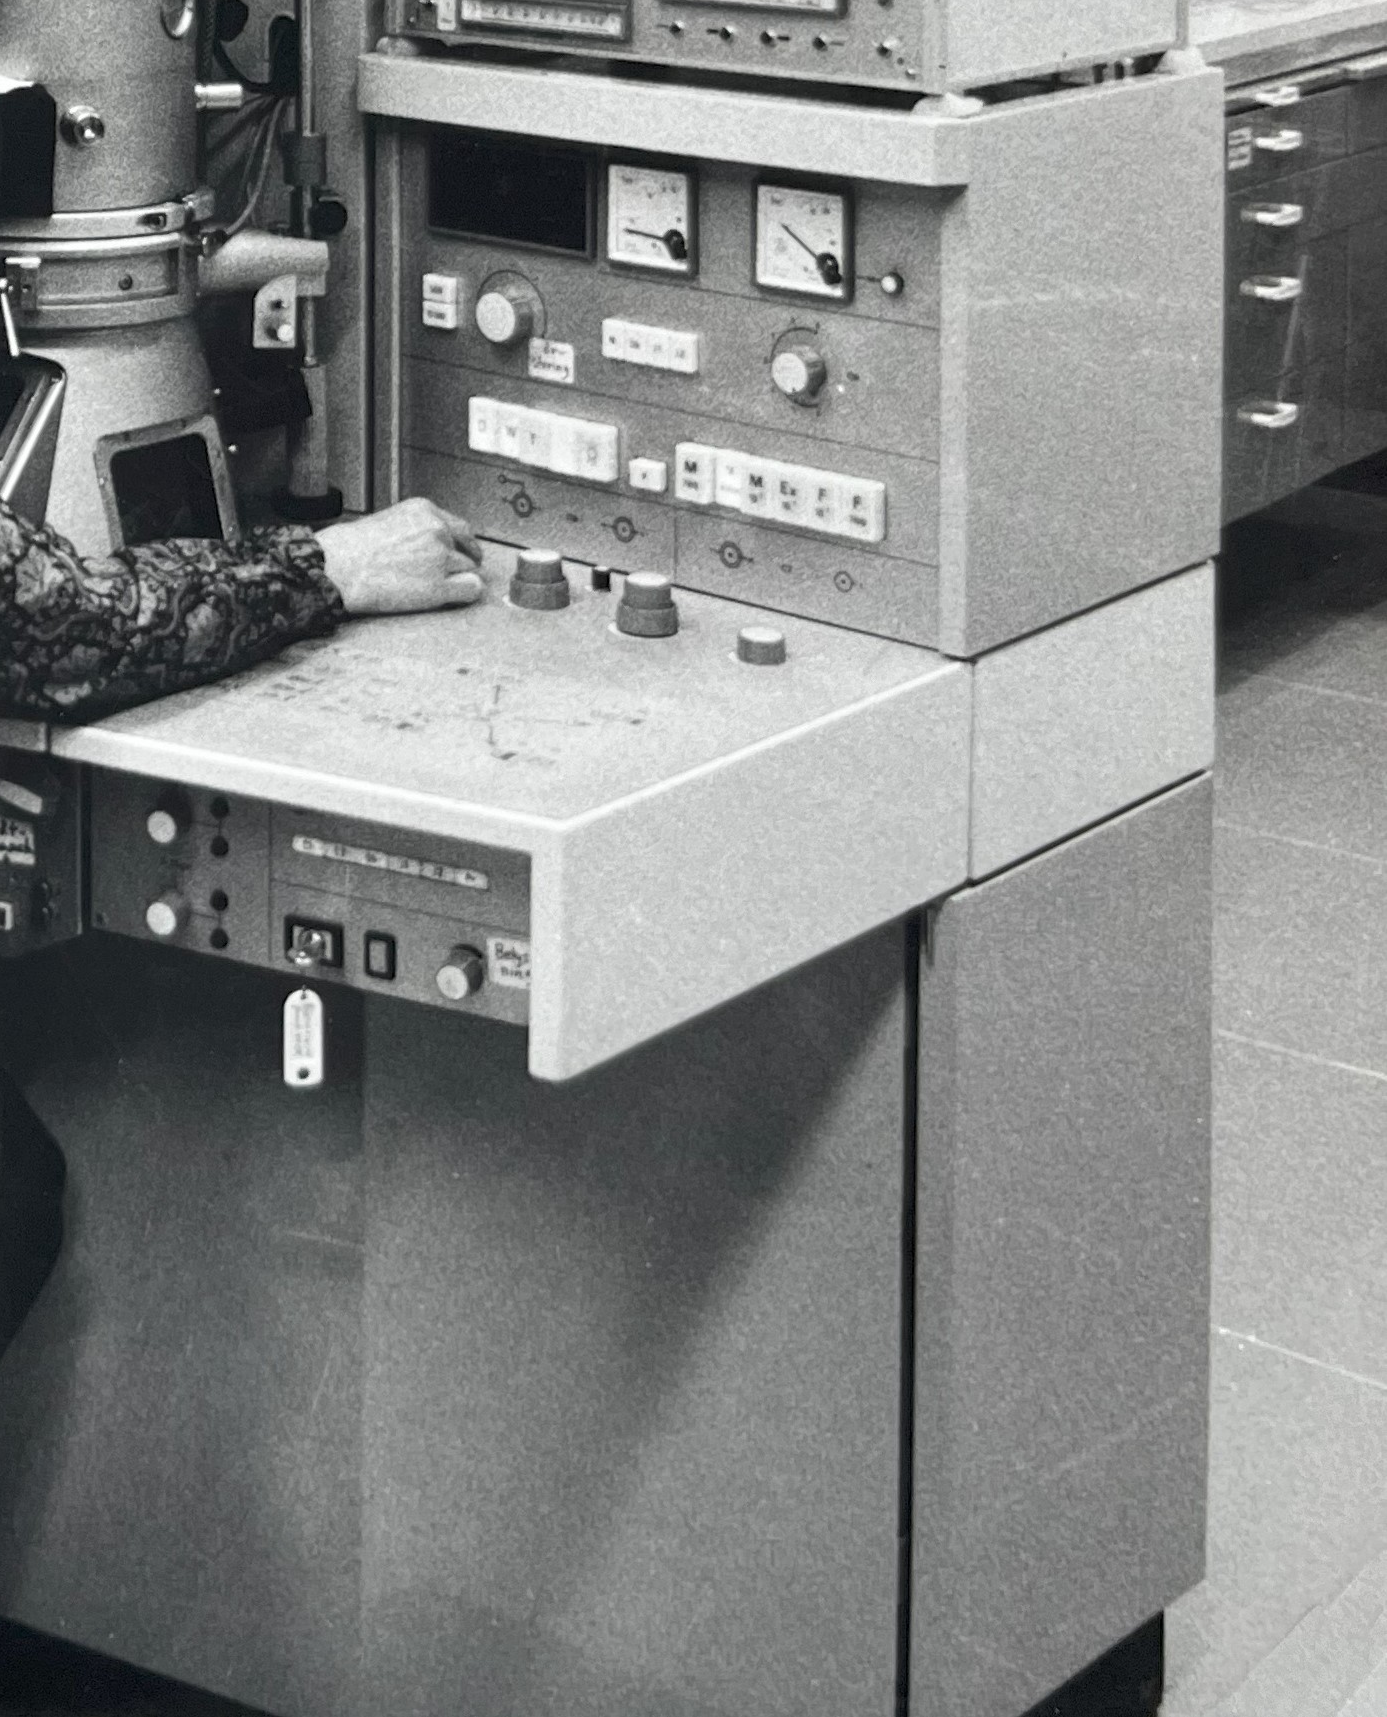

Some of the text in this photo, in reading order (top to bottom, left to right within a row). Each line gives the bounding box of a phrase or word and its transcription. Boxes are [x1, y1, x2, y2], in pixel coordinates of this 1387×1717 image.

[684, 460, 698, 474] M
[749, 473, 763, 488] M
[779, 480, 797, 497] Ex
